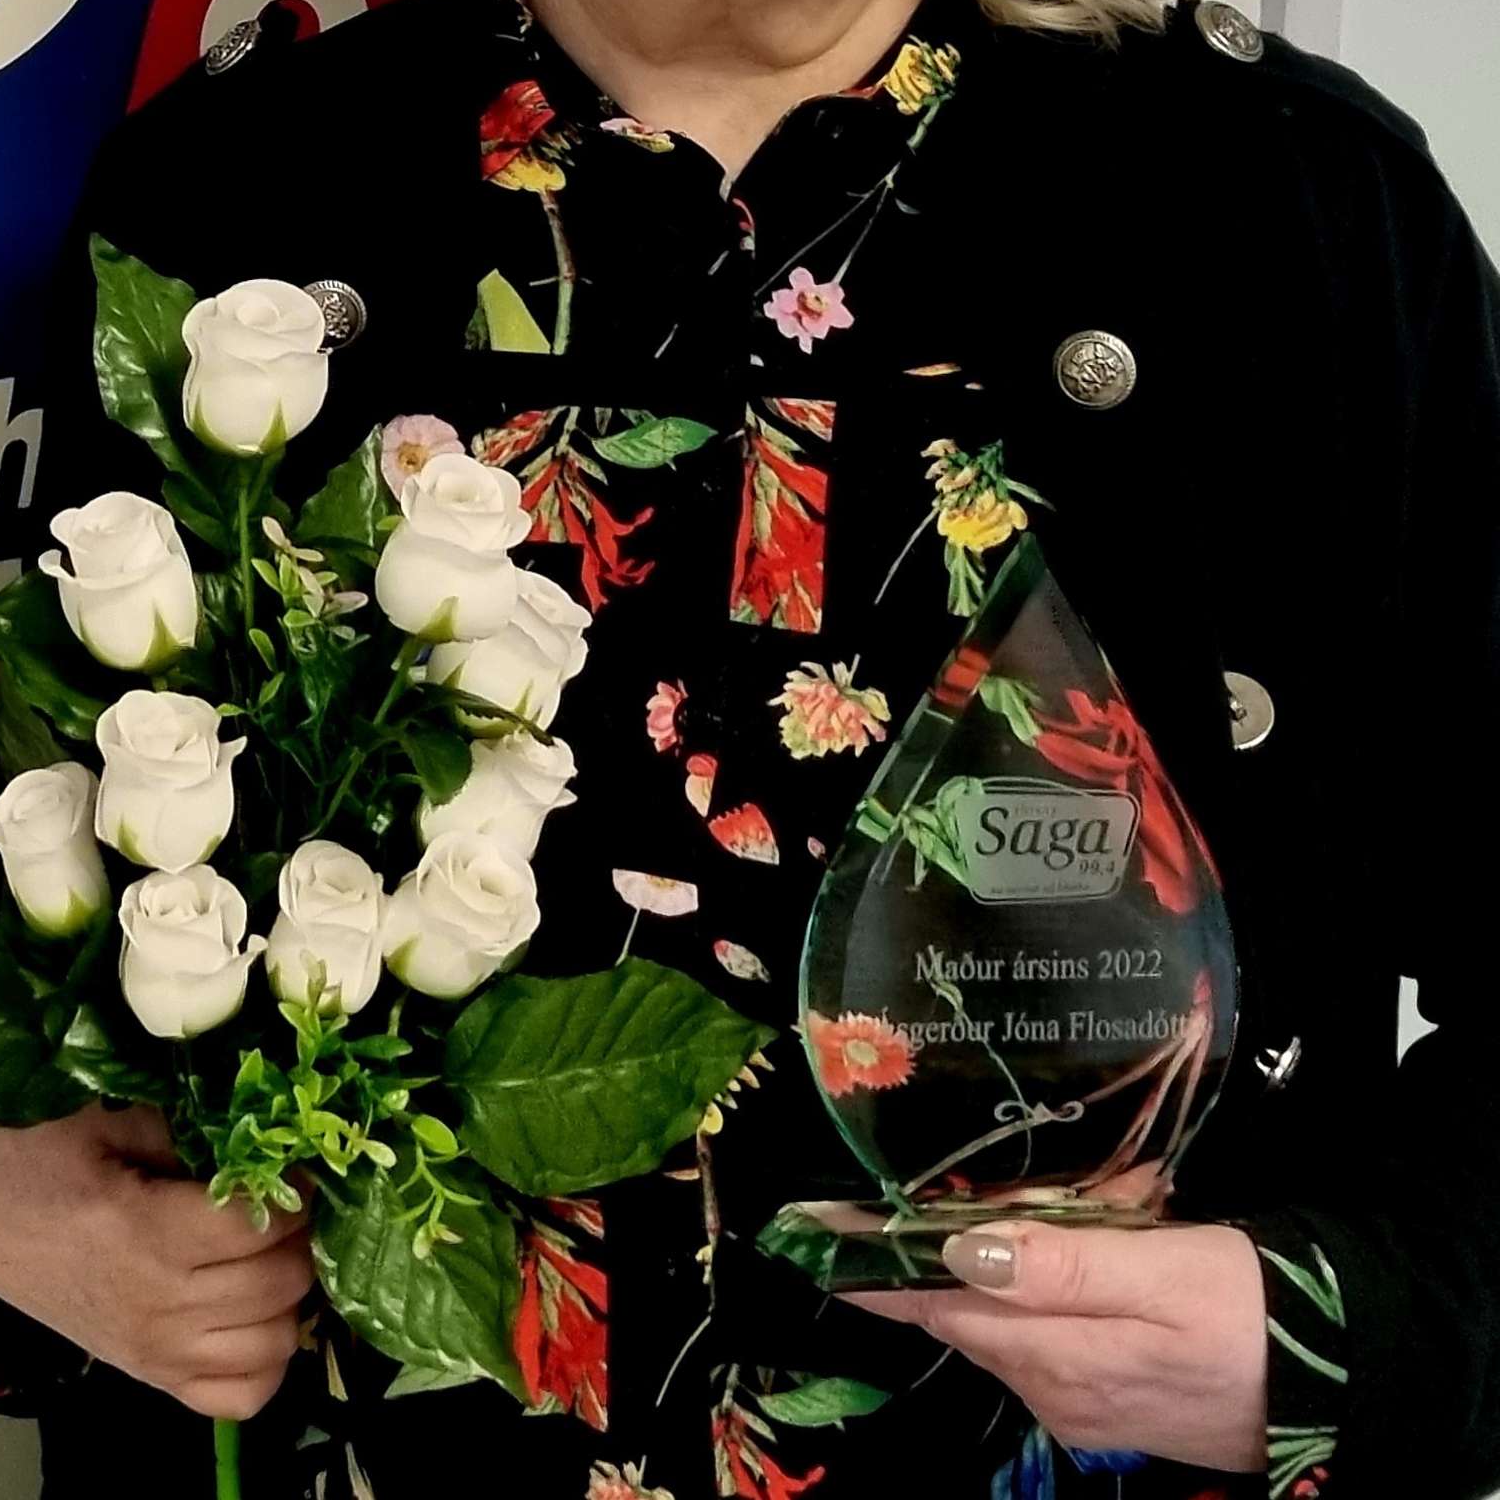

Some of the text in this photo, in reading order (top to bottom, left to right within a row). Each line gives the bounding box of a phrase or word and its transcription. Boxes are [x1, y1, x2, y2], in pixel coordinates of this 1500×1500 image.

[975, 806, 1113, 871] Saga
[914, 949, 1164, 981] Maður ársins 2022
[1001, 1011, 1061, 1043] Jóna
